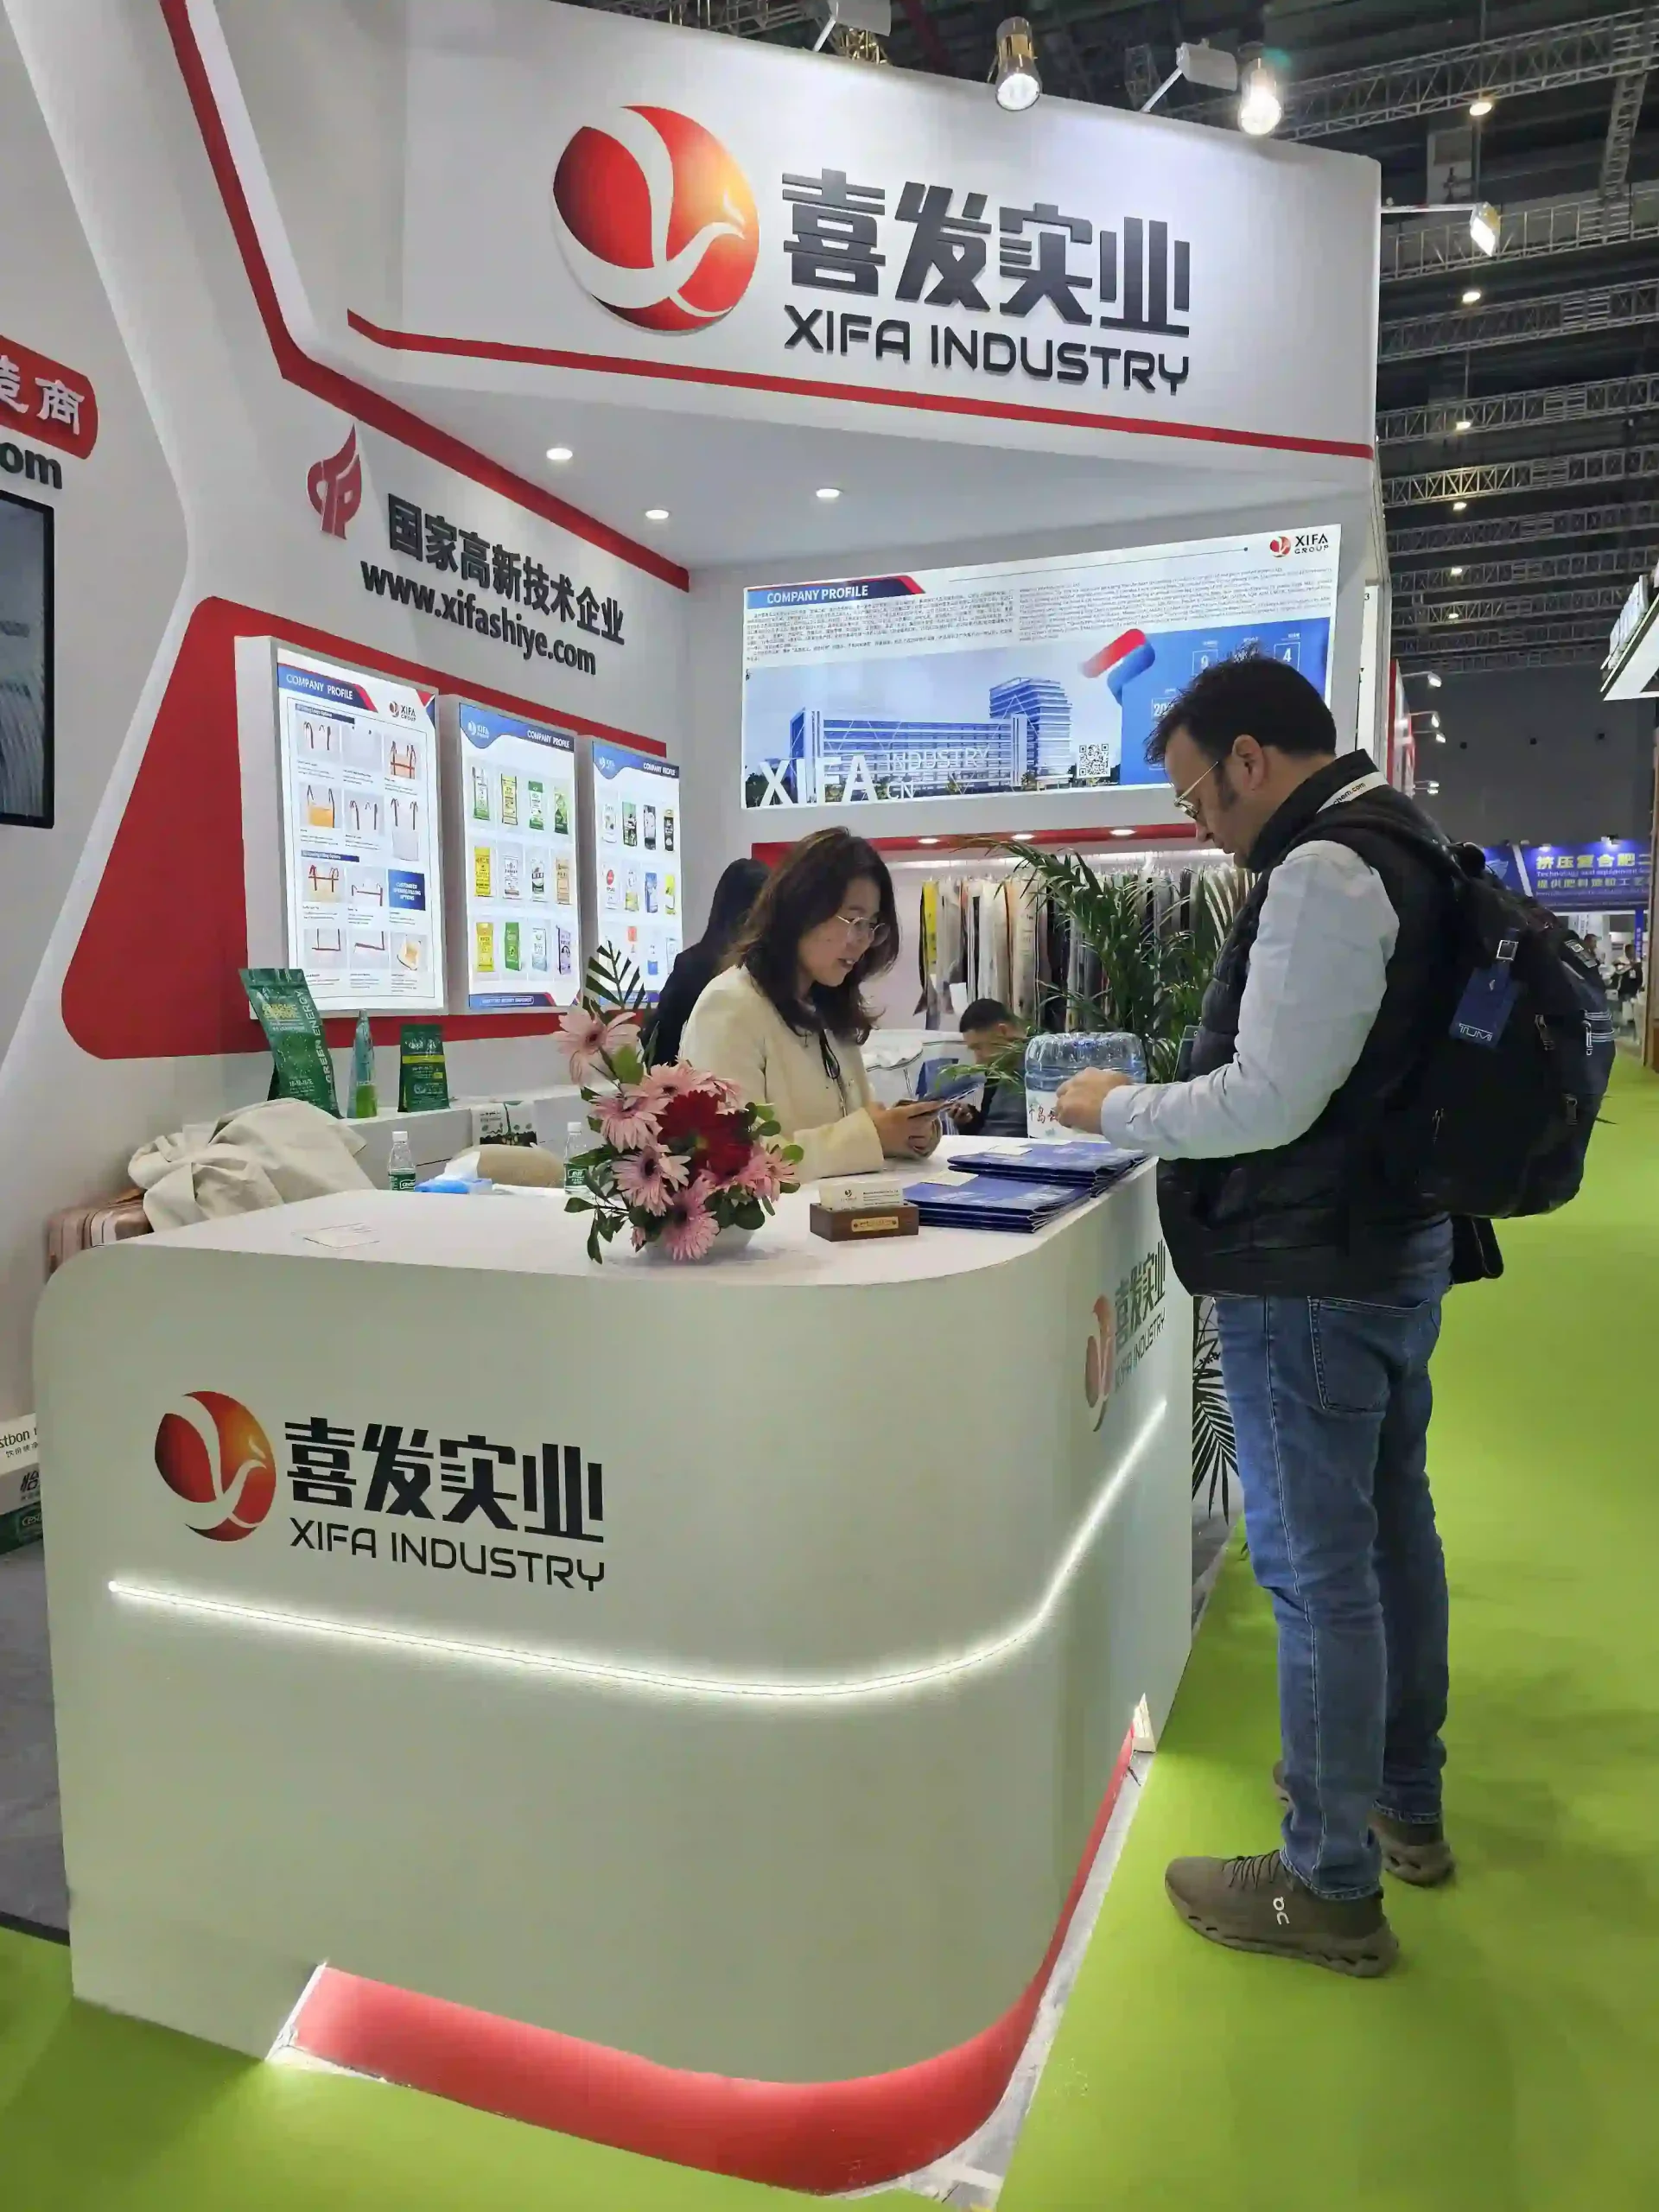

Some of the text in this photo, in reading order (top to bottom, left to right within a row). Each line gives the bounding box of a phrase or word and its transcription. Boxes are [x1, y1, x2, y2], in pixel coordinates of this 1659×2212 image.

[781, 168, 1191, 337] 喜发实业
[784, 304, 1191, 394] XIFA INDUSTRY
[387, 493, 625, 645] 国家高新技术企业
[1294, 544, 1329, 555] GROUP
[1295, 533, 1329, 548] XIFA
[360, 560, 596, 675] www.xifashiye.com
[766, 585, 869, 604] COMPANY PROFILE
[286, 674, 353, 701] COMPANY PROFILE
[527, 729, 551, 743] COMPANY
[886, 745, 990, 771] INDUSTRY
[759, 753, 878, 807] XIFA
[295, 989, 332, 1084] GREEN ENERGY
[1459, 1023, 1493, 1042] TUMI
[1115, 1239, 1166, 1355] 喜发实业
[284, 1416, 604, 1543] 喜发实业
[289, 1516, 605, 1592] XIFA INDUSTRY
